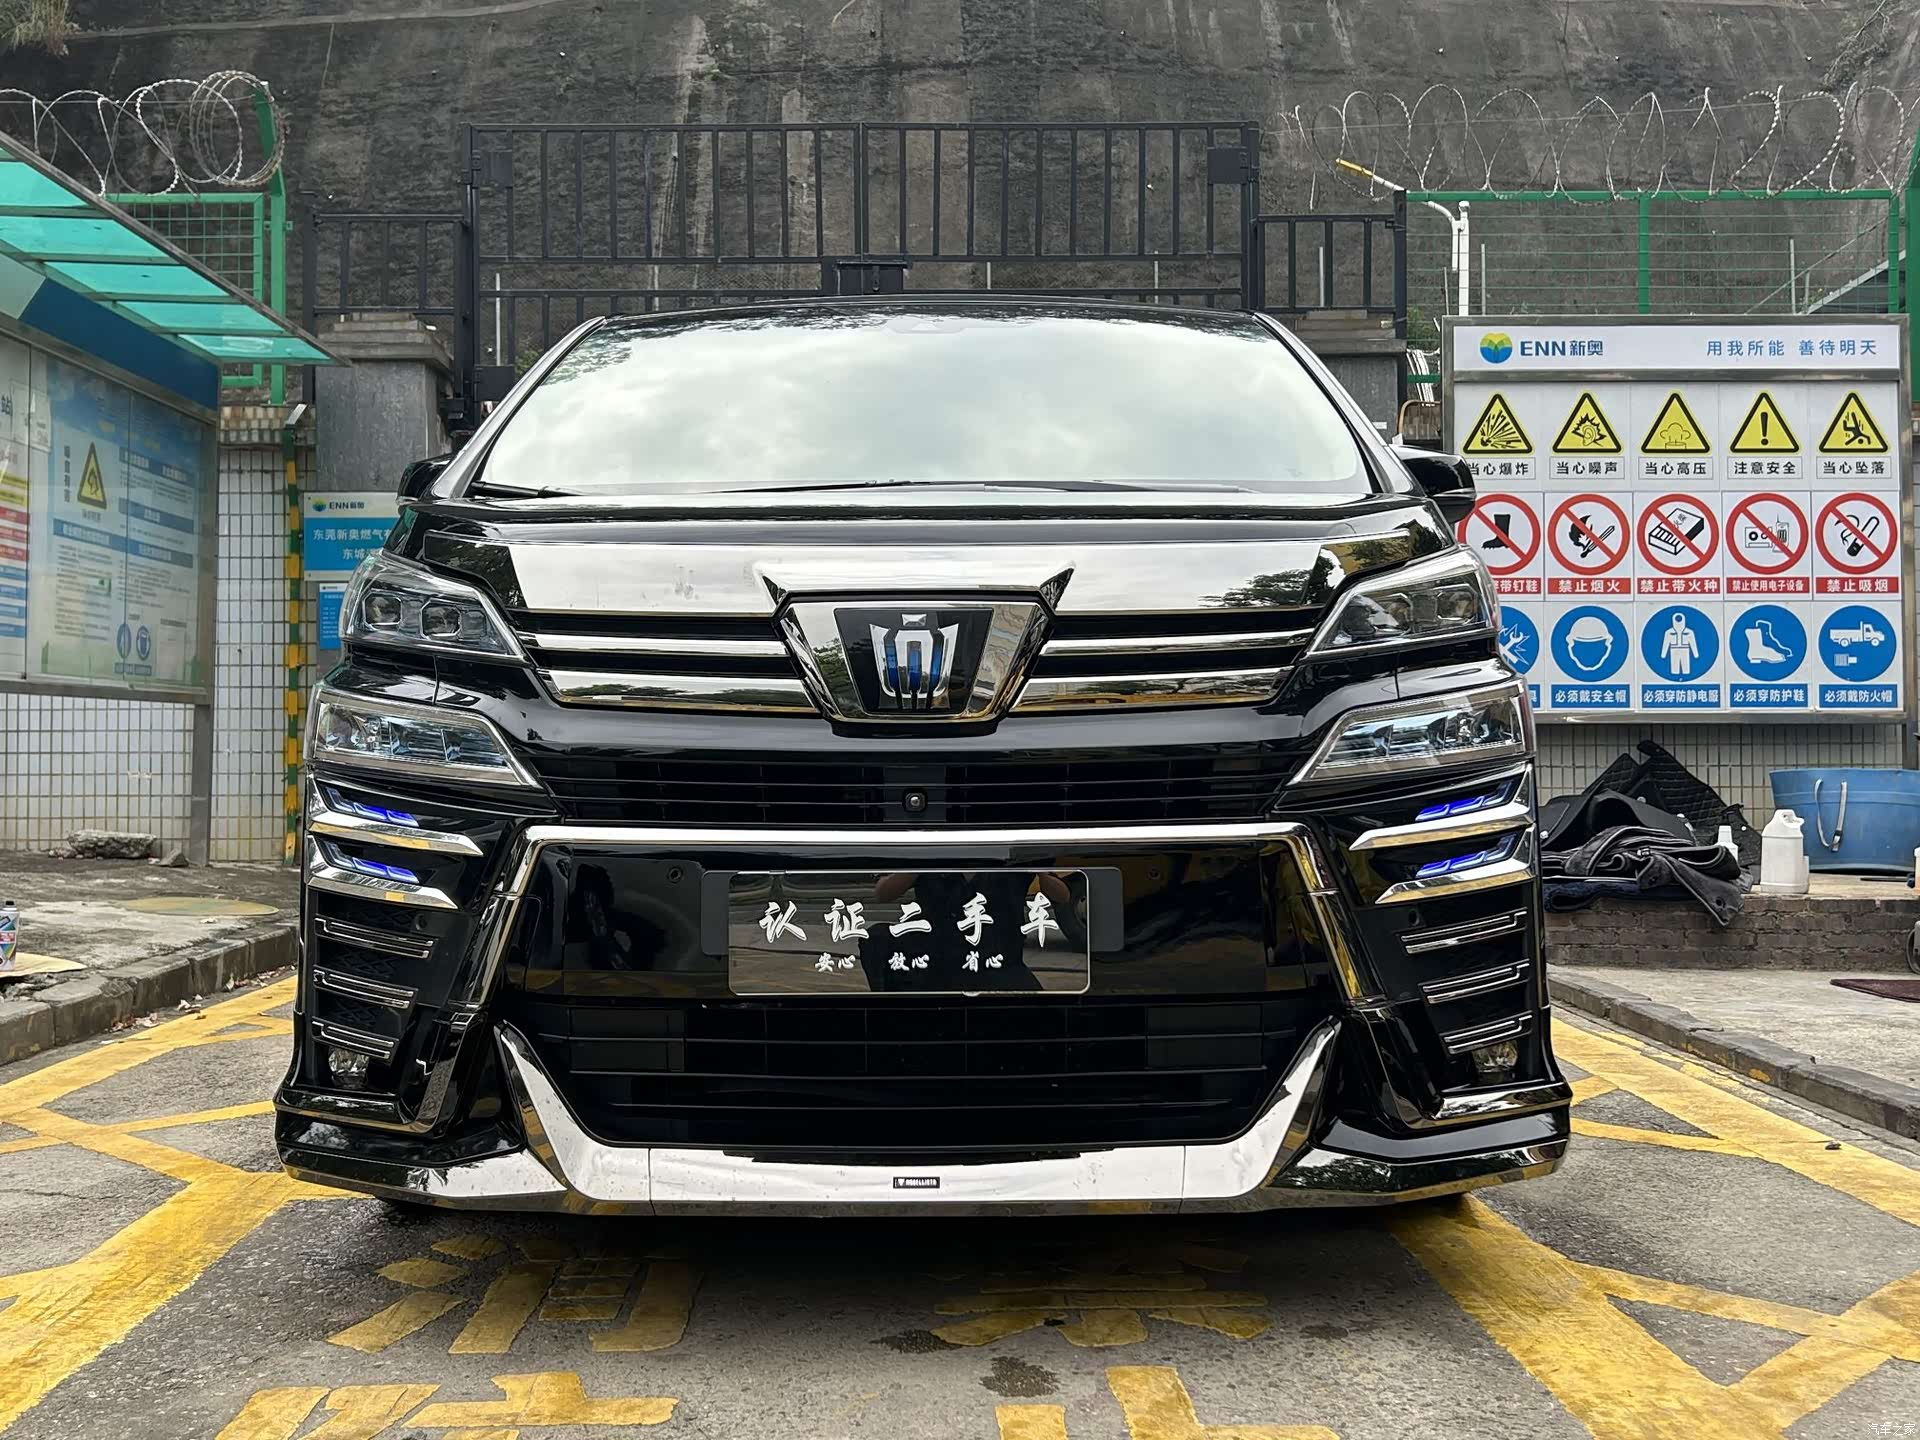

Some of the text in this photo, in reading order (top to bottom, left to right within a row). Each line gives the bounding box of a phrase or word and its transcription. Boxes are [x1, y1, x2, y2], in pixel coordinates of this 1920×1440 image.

[1519, 339, 1604, 358] ENN新奥
[1706, 339, 1878, 357] 用我所能 善待明天
[1556, 461, 1618, 476] 当心噪声
[1645, 461, 1707, 476] 当心高压
[1734, 461, 1797, 476] 注意安全
[1823, 461, 1886, 476] 当心坠落
[1558, 578, 1620, 593] 禁止烟火
[1640, 578, 1719, 593] 禁止带火种
[1732, 579, 1804, 592] 禁止使用电子设备
[1827, 578, 1889, 593] 禁止吸烟
[1555, 689, 1627, 703] 必须戴安全帽
[1643, 689, 1719, 703] 必须穿防静电服
[1733, 689, 1805, 703] 必须穿防护鞋
[1824, 689, 1893, 703] 必须戴防火帽
[758, 891, 1061, 948] 认证二手车
[814, 952, 1004, 973] 安心 放心 省心
